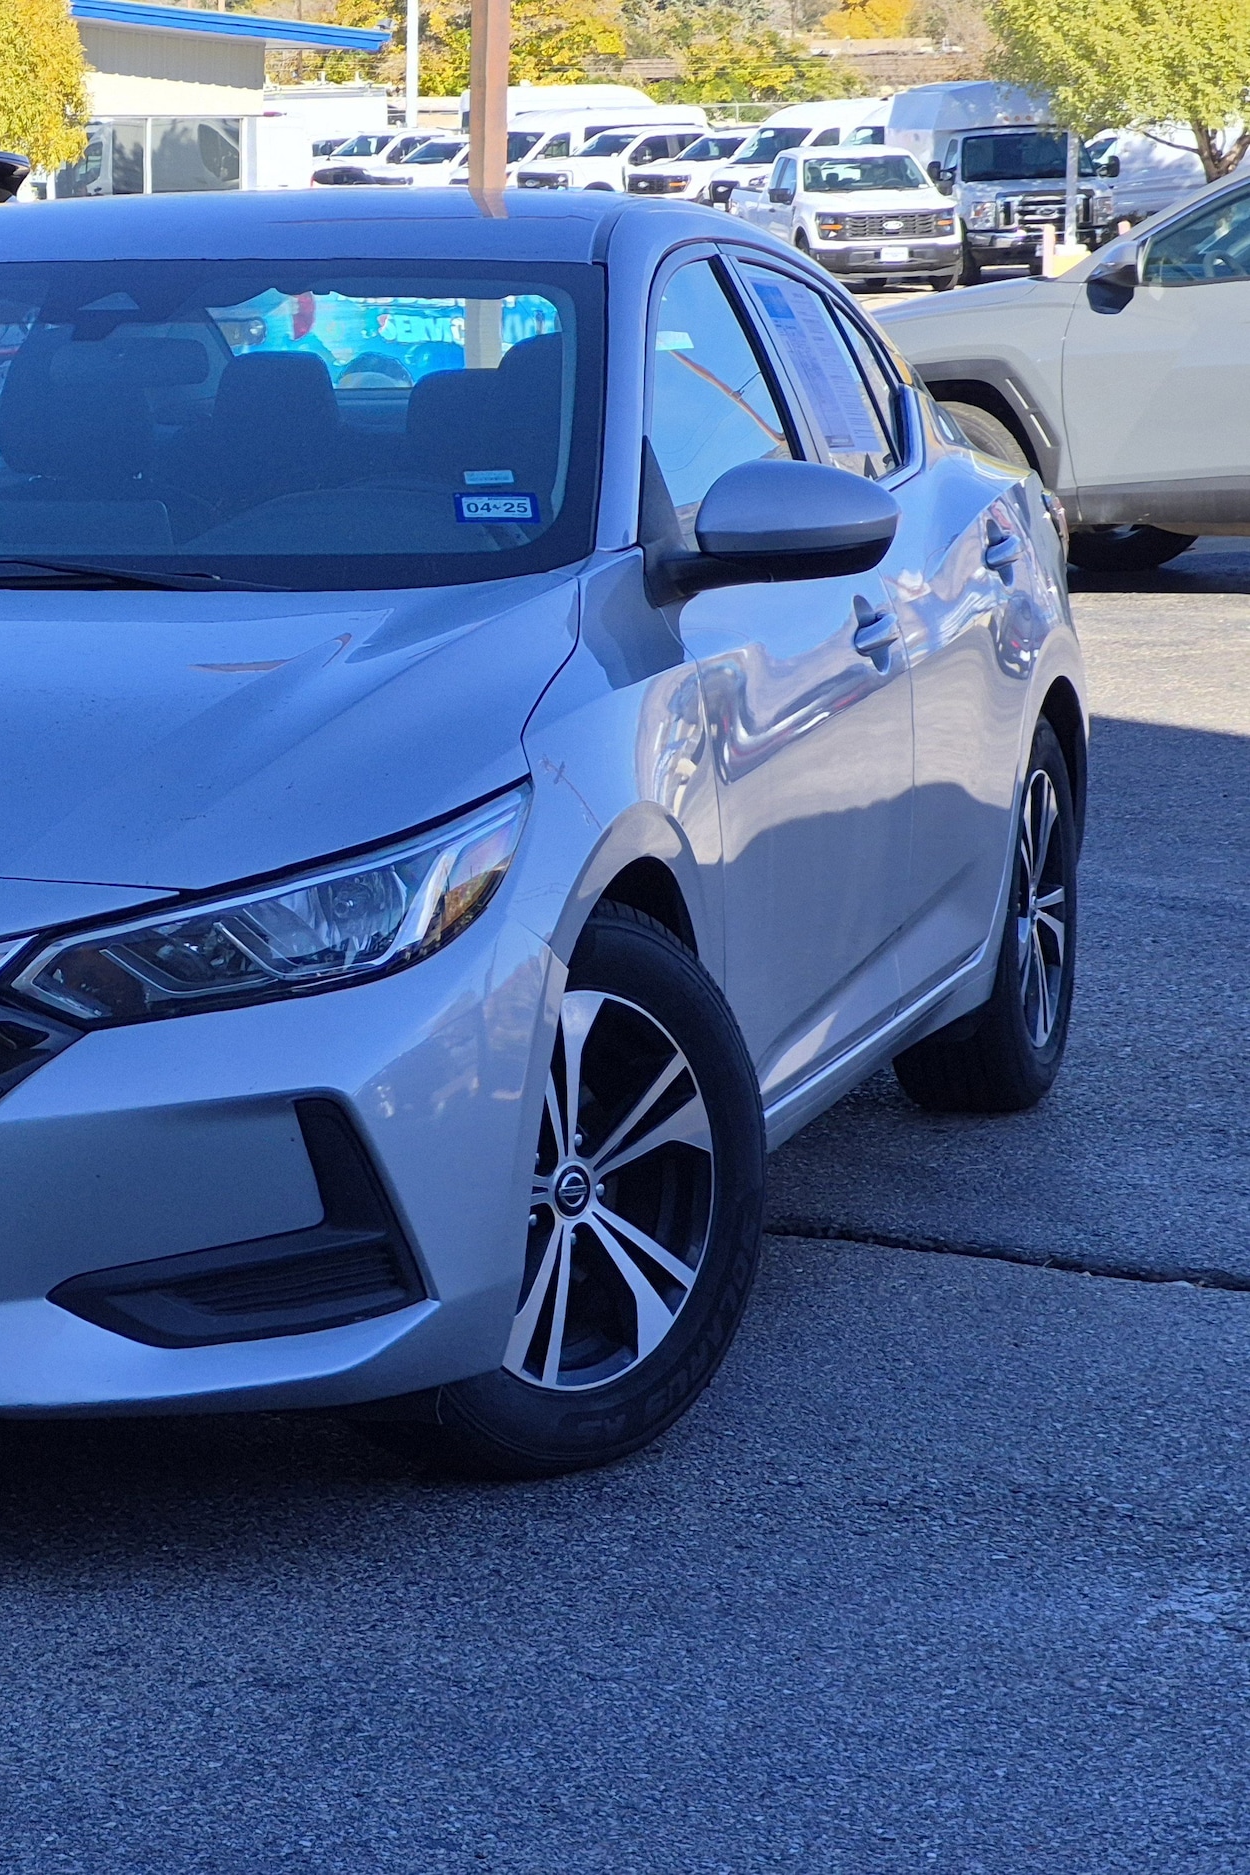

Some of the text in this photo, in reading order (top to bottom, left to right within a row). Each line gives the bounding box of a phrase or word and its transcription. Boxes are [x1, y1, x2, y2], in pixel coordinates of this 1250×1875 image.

[378, 314, 466, 345] SERVIC
[466, 502, 528, 513] 04 25
